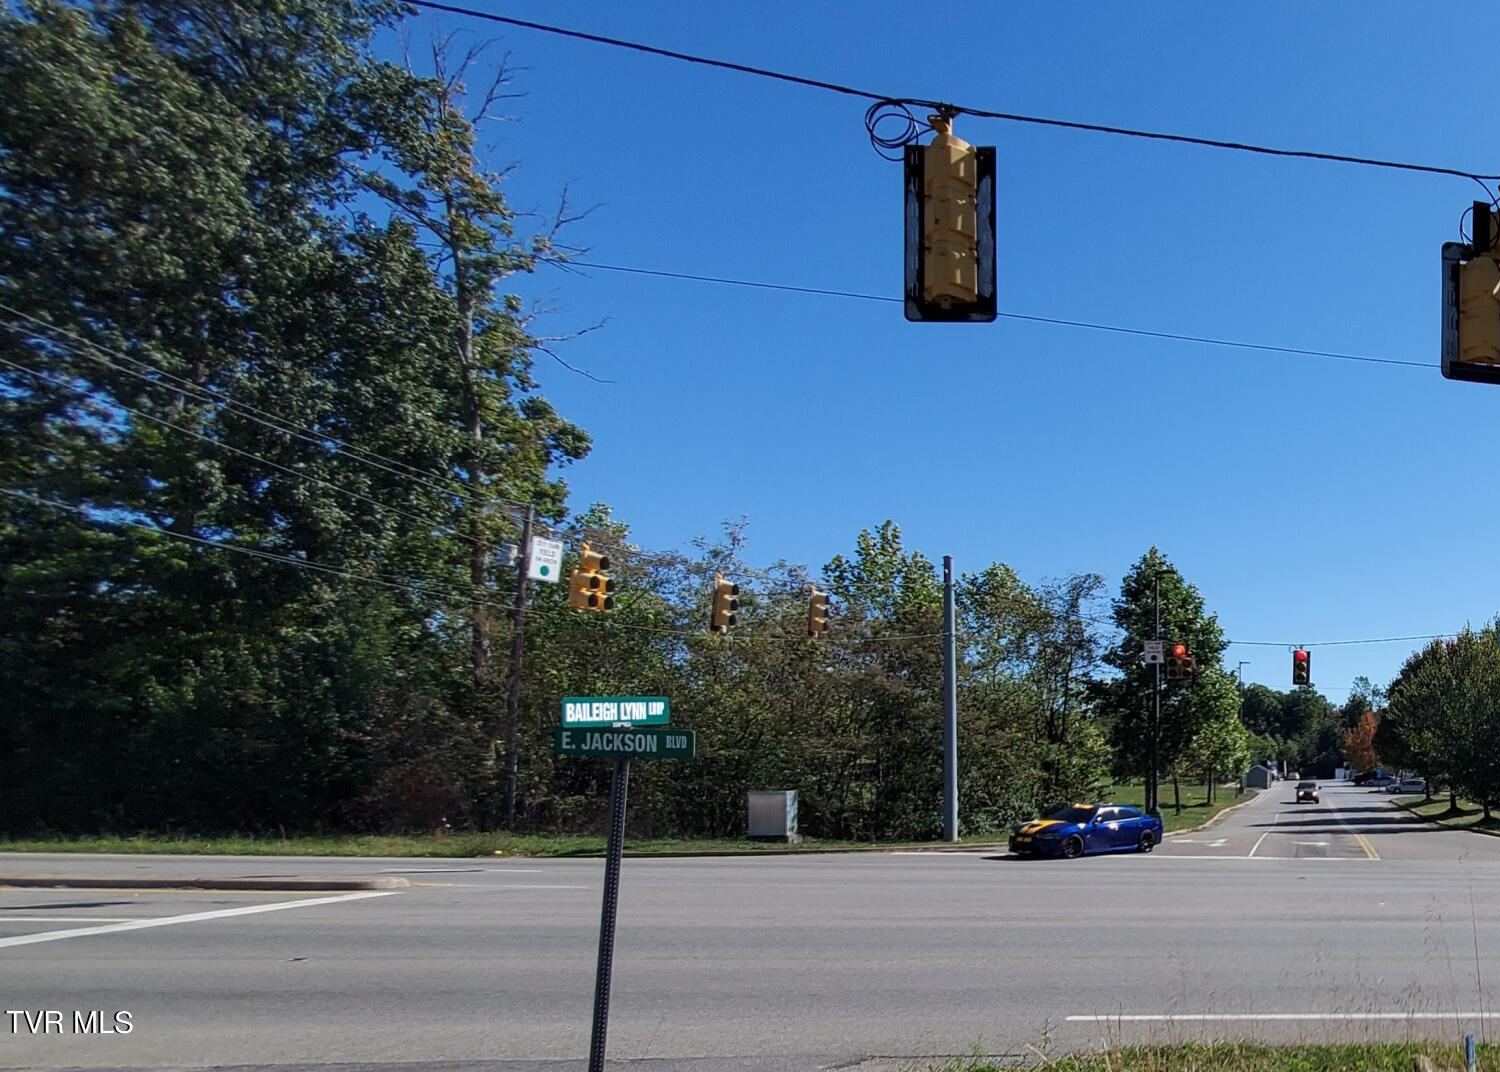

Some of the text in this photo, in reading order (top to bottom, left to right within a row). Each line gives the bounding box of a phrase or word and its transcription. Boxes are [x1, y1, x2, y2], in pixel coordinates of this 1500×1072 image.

[566, 702, 618, 722] BAILEIGH
[620, 702, 647, 720] LYNN
[562, 732, 687, 753] E. JACKSON BLVD
